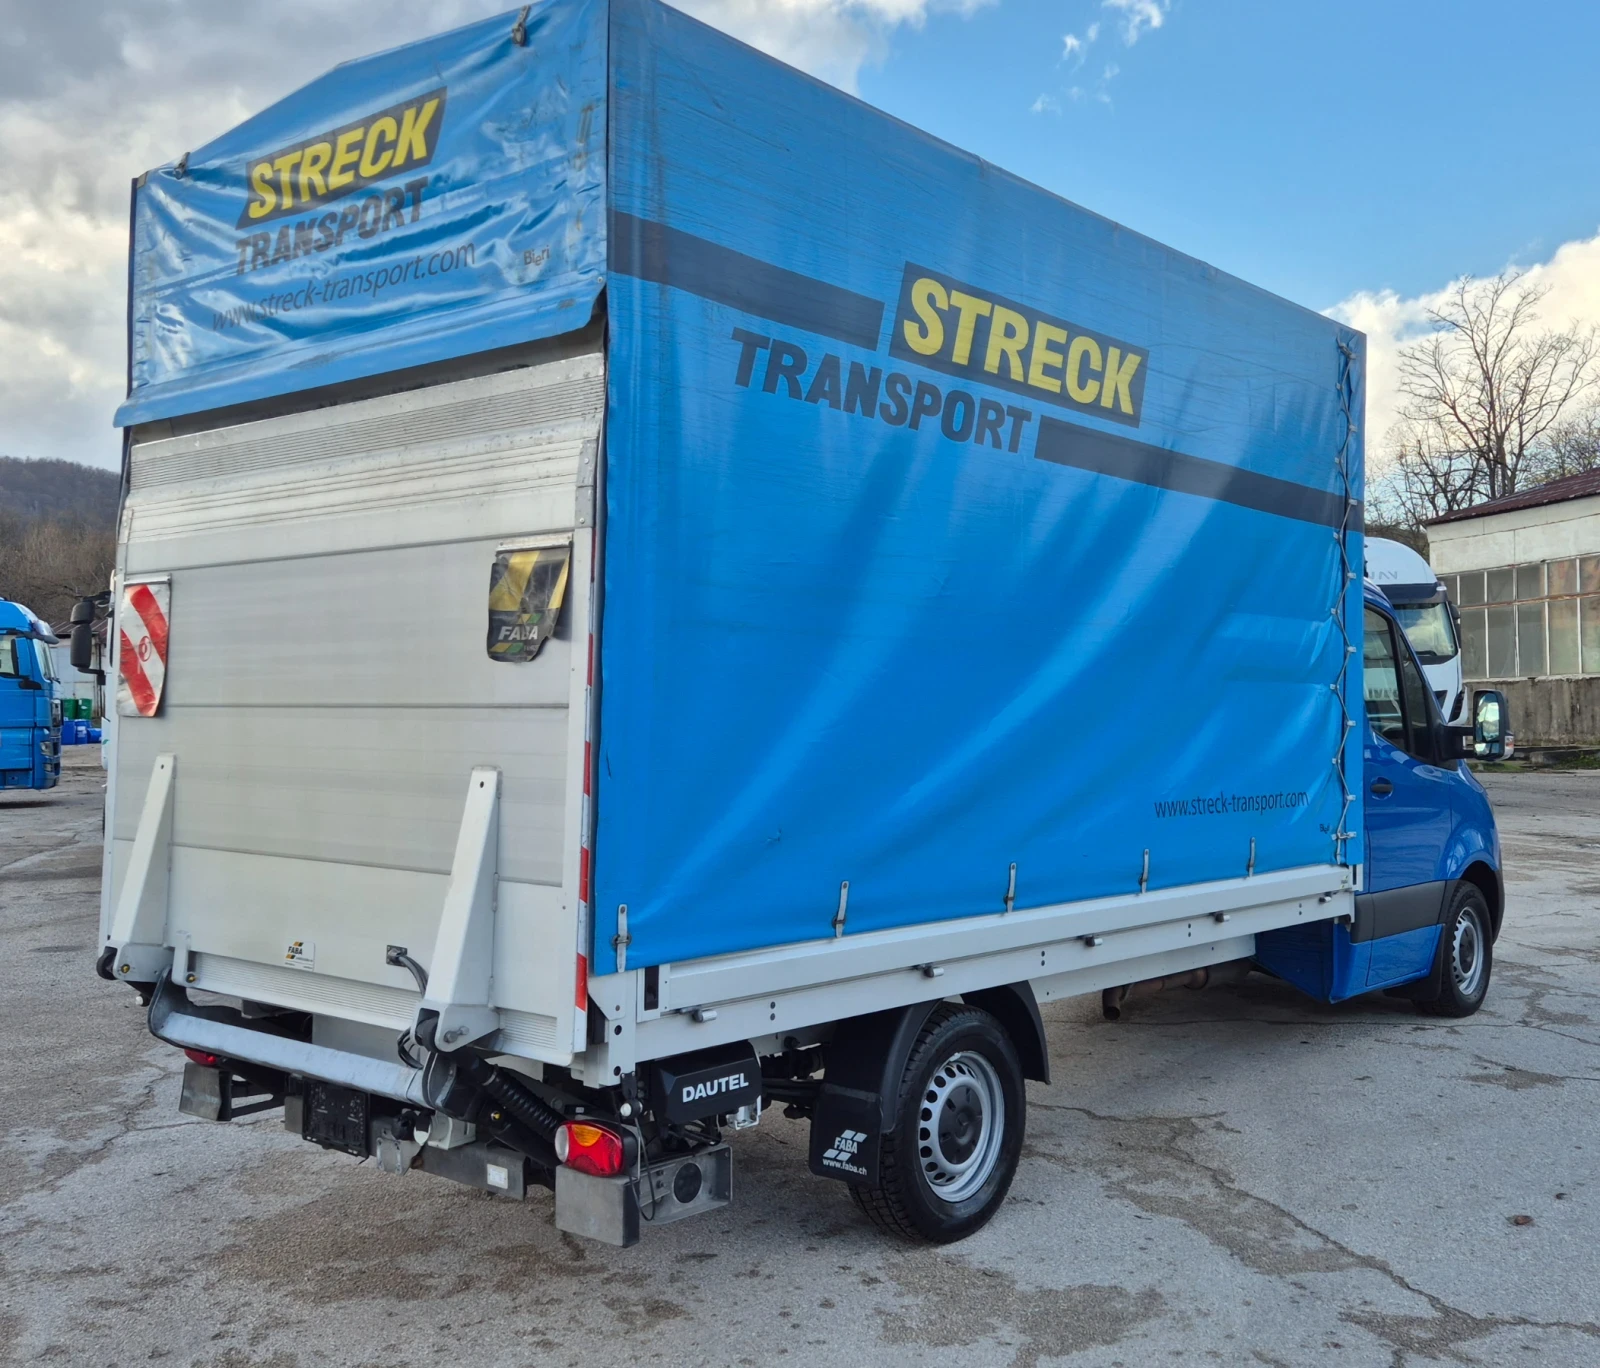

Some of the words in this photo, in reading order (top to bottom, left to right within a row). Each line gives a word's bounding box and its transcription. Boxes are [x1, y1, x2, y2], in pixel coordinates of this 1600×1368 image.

[249, 99, 439, 219] STRECK
[235, 176, 428, 276] TRANSPORT
[212, 241, 476, 331] www.streck-transport.com
[732, 327, 1032, 454] TRANSPORT
[903, 277, 1142, 416] STRECK
[1154, 790, 1309, 818] www.streck-transport.com
[682, 1073, 749, 1103] DAUTEL
[822, 1158, 868, 1176] www.faba.ch
[834, 1137, 858, 1154] FABA
